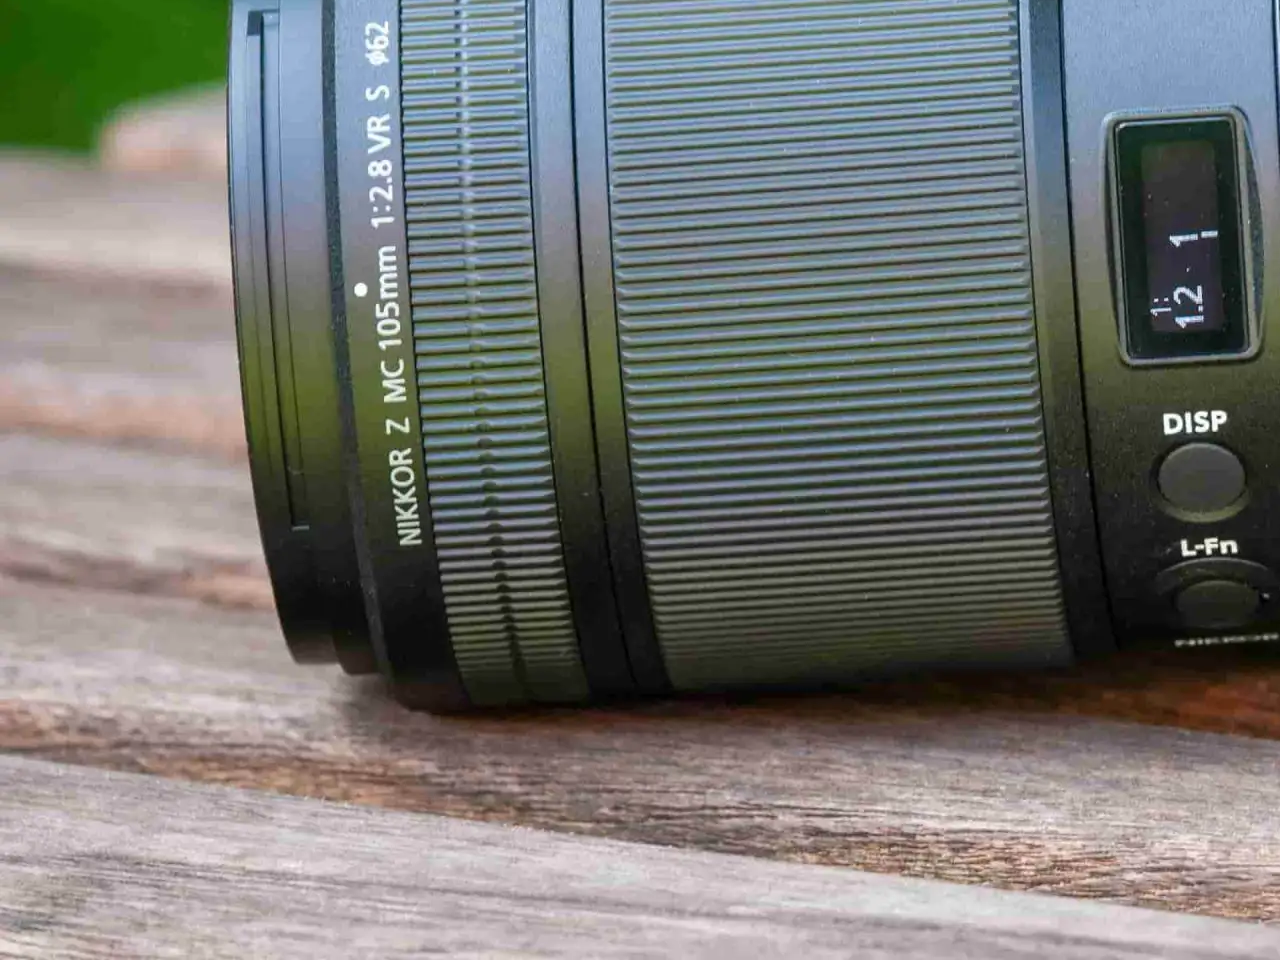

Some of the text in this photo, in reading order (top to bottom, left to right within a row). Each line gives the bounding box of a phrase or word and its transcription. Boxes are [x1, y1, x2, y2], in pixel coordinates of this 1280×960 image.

[365, 84, 391, 102] S
[366, 113, 393, 155] VR
[367, 159, 396, 230] 1:2.8
[375, 244, 402, 351] 105mm
[380, 358, 407, 403] MC
[385, 416, 410, 436] Z
[1163, 410, 1228, 435] DISP
[388, 446, 422, 547] NIKKOR
[1180, 538, 1238, 557] L-Fn
